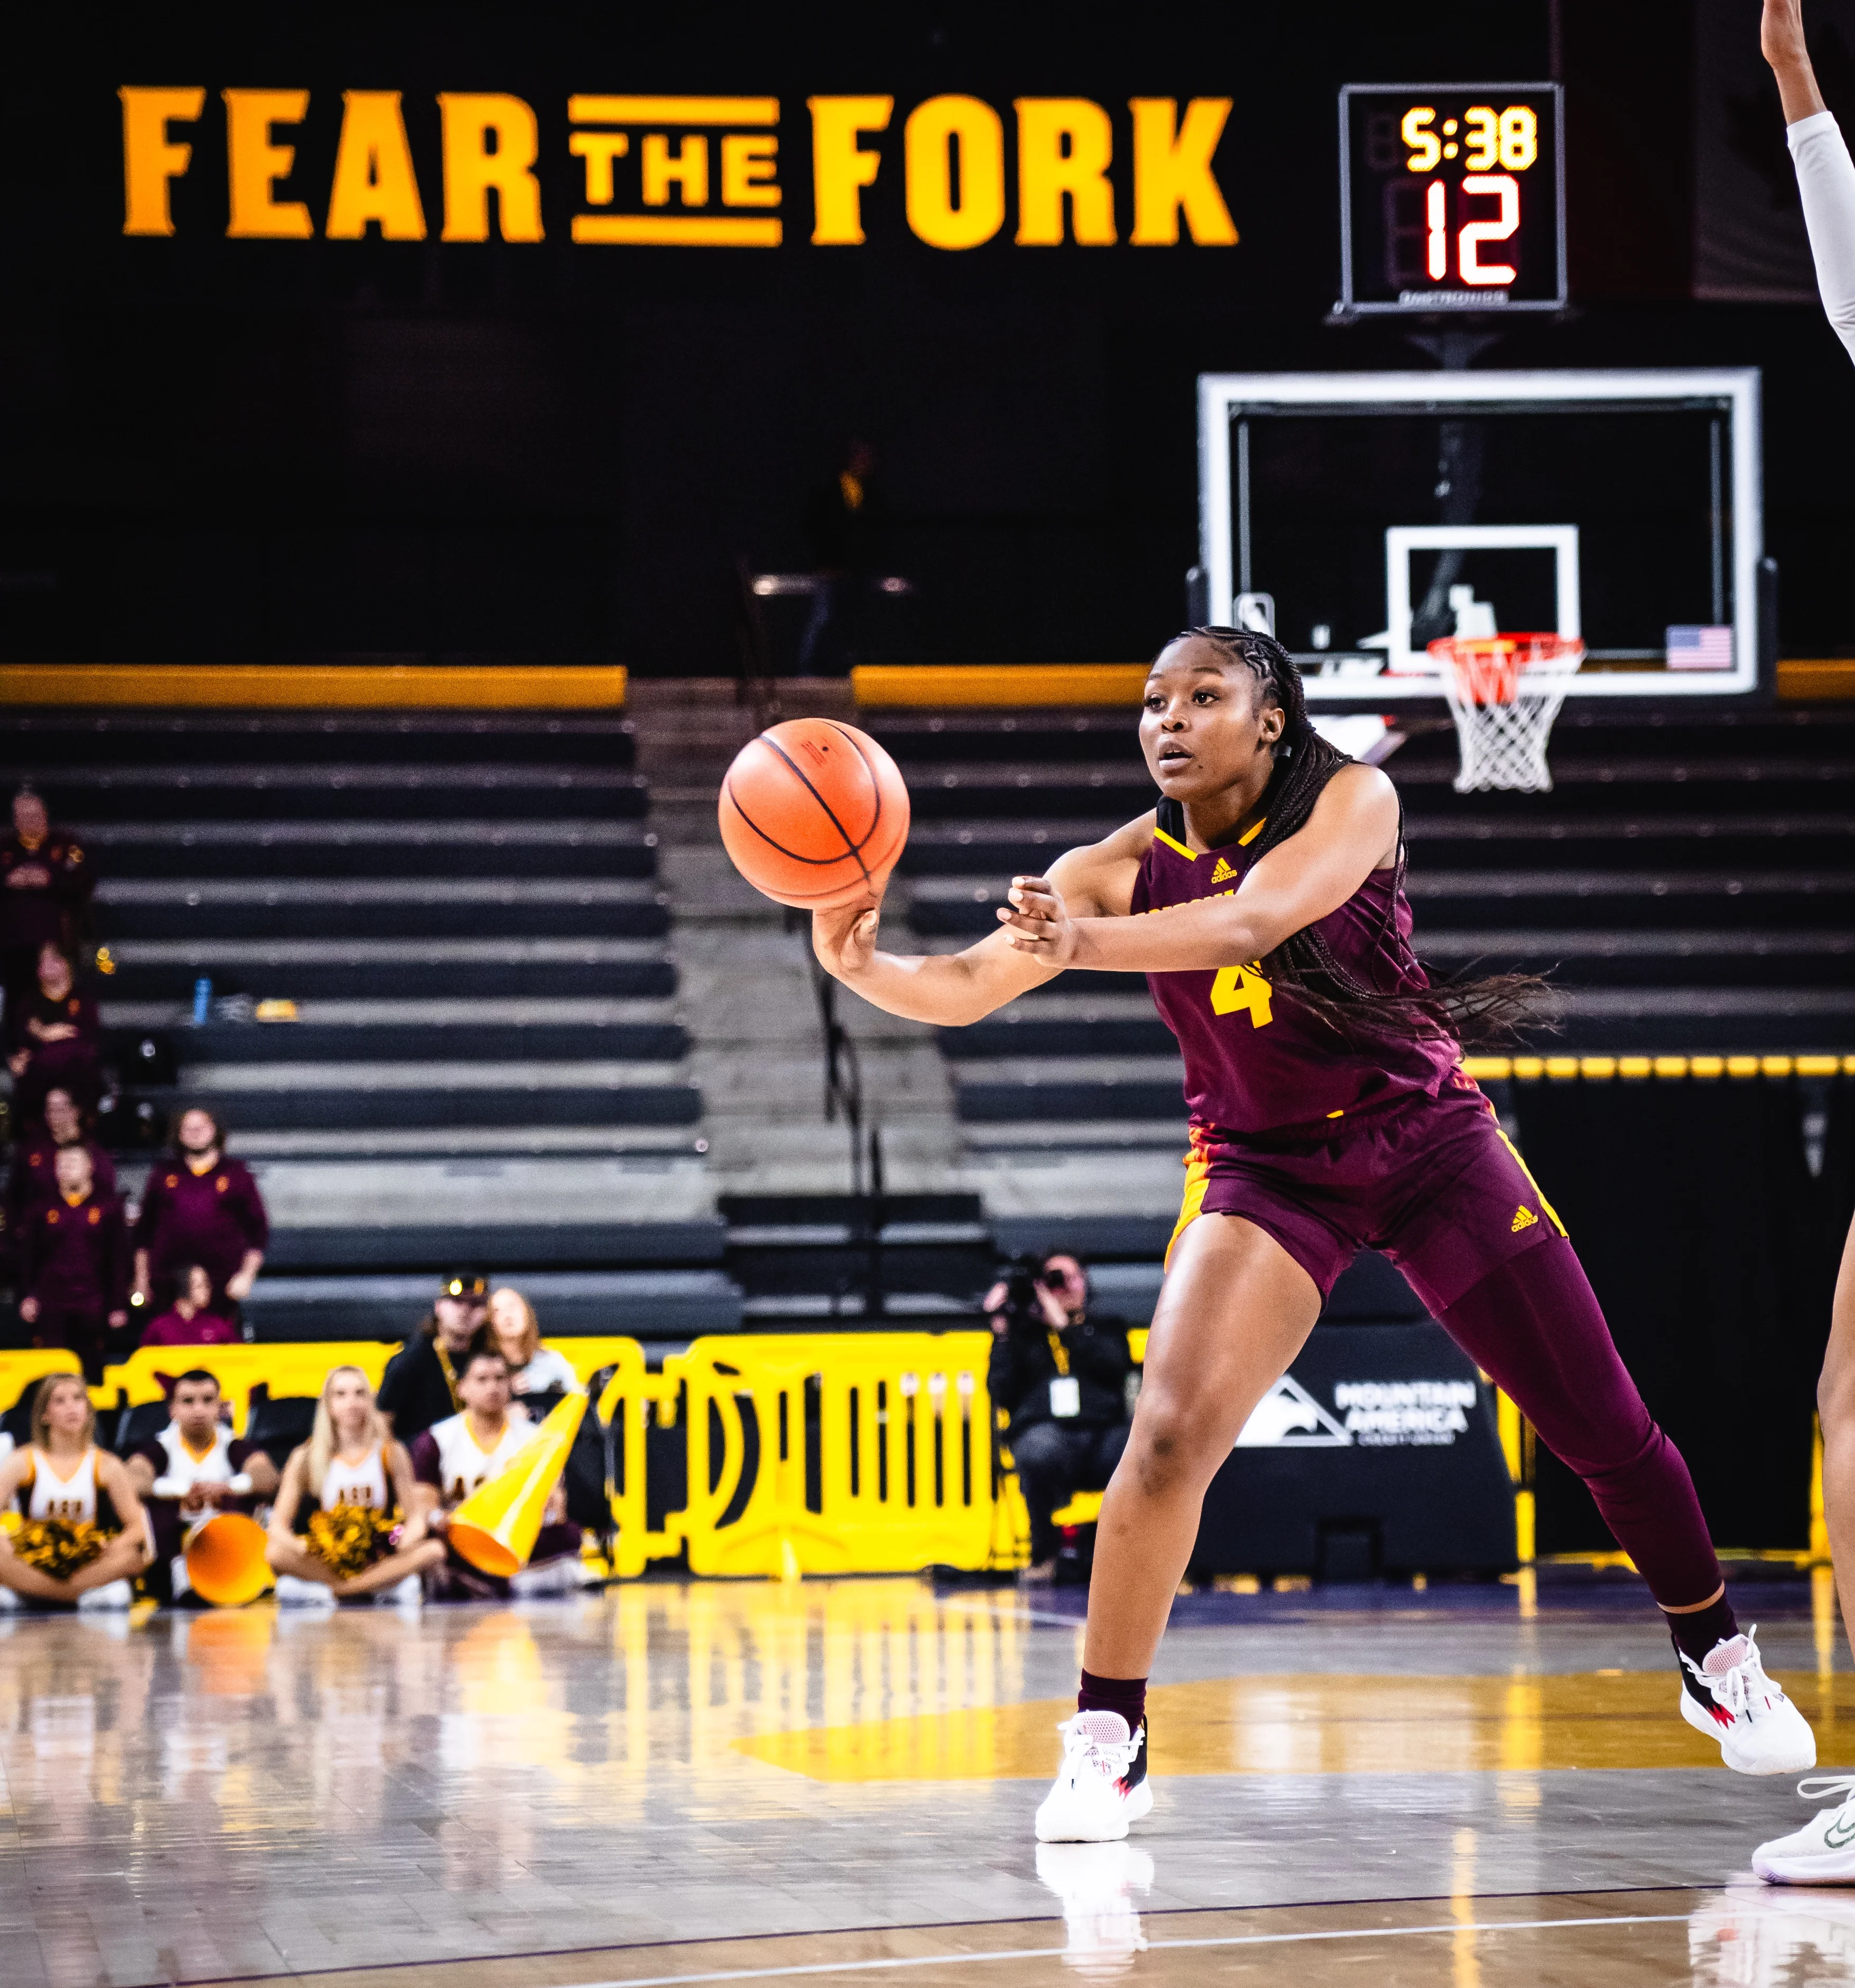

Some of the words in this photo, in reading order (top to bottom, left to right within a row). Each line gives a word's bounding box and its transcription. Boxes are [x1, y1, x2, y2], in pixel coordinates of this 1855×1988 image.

[1401, 106, 1538, 172] 5:38
[117, 85, 546, 244] FEAR
[568, 130, 783, 207] THE
[805, 94, 1240, 250] FORK
[1427, 173, 1520, 285] 12
[1211, 870, 1238, 884] adidas
[1211, 961, 1273, 1029] 4
[1511, 1215, 1539, 1233] adidas
[1335, 1382, 1475, 1408] MOUNTAIN
[1345, 1407, 1467, 1432] AMERICA
